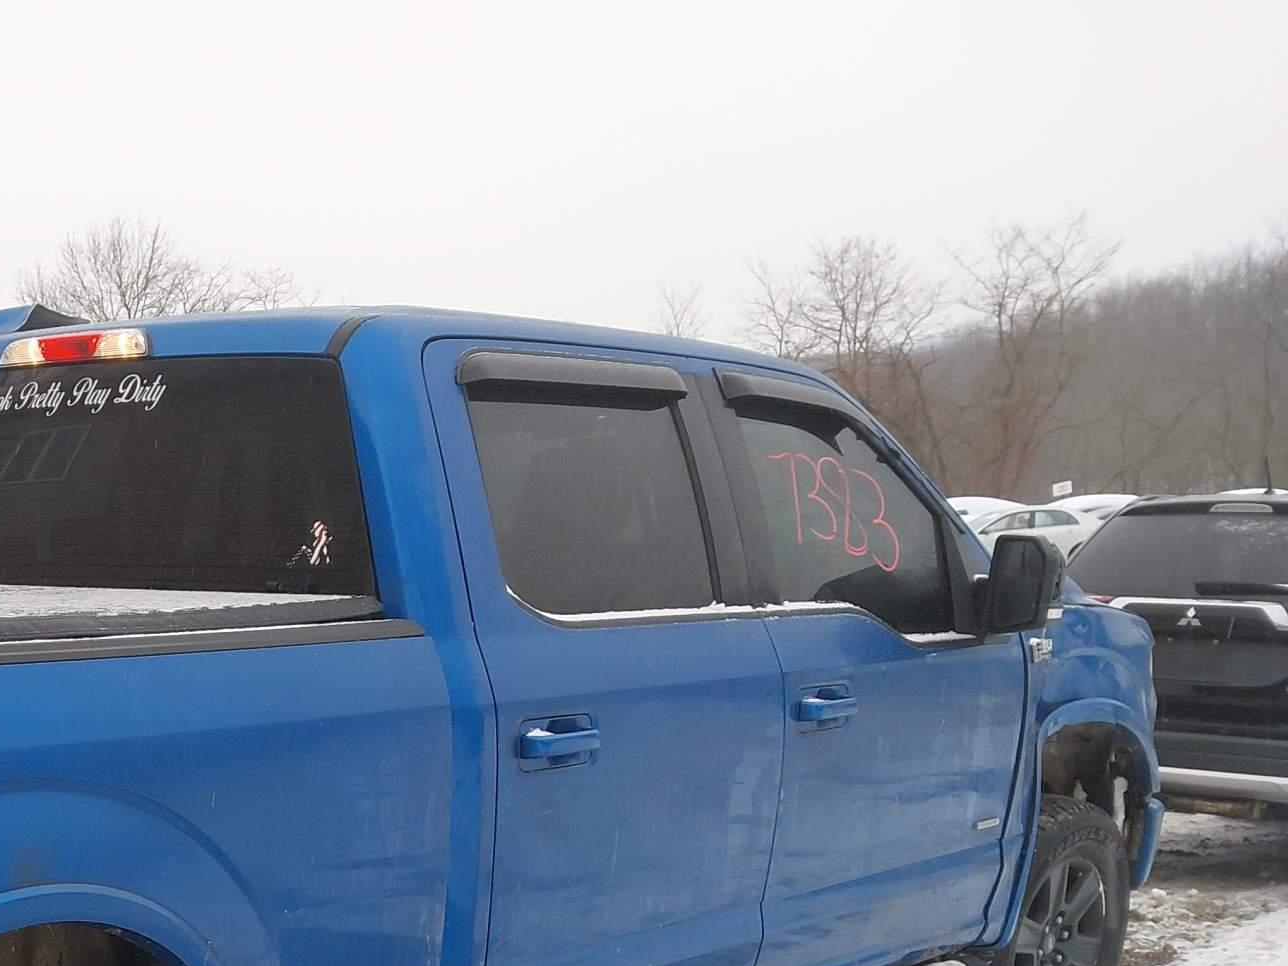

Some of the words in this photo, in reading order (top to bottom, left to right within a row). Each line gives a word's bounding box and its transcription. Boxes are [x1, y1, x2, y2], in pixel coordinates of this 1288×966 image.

[14, 381, 65, 416] Pretty
[67, 377, 111, 413] Play
[113, 373, 167, 411] Dirty
